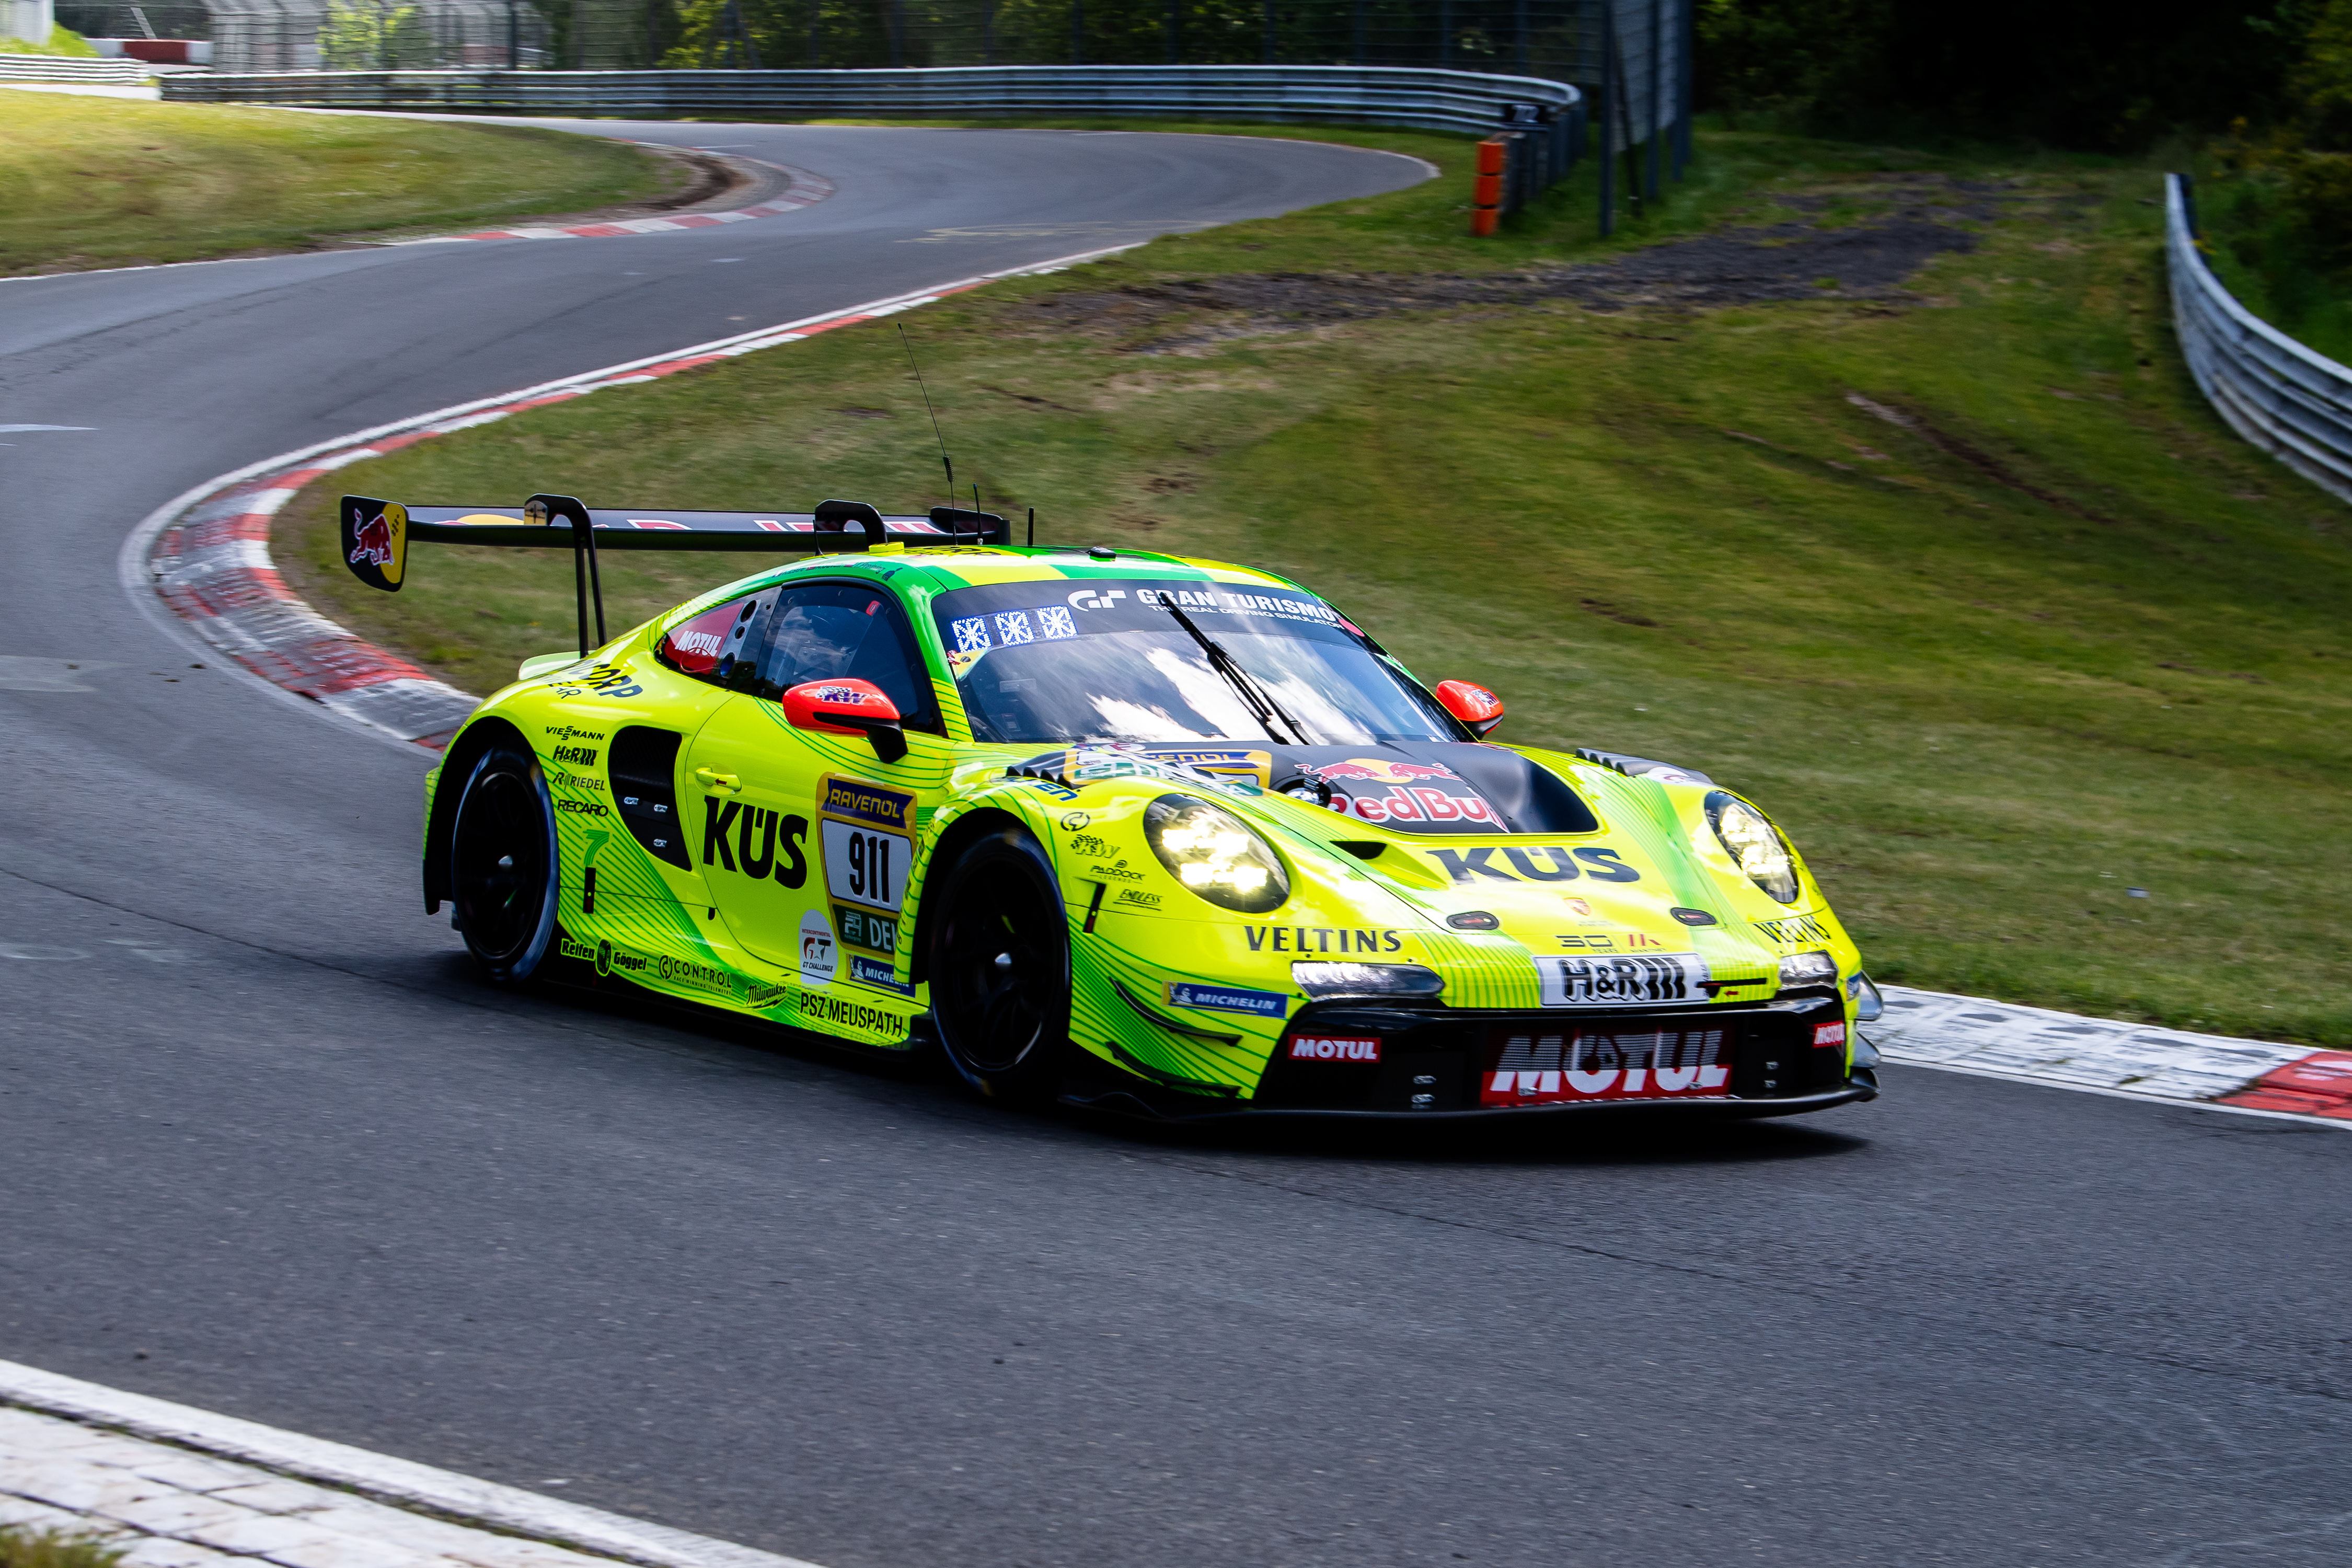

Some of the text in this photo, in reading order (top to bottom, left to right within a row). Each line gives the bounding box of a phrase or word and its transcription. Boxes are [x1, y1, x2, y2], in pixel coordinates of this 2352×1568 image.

[1136, 589, 1219, 607] GRAN
[1220, 592, 1336, 622] TURISMO
[1218, 607, 1275, 618] DRIVING
[1274, 612, 1345, 630] SIMULATOR
[674, 630, 722, 657] MOTUL
[546, 725, 605, 741] VIESSMANN
[552, 745, 584, 765] H&R
[570, 775, 605, 791] RIEDEL
[557, 799, 609, 817] RECARO
[829, 788, 900, 818] RAVENOL
[703, 794, 809, 890] KÜS
[849, 831, 890, 904] 911
[1090, 865, 1146, 881] PADDOCK
[1425, 847, 1641, 885] KÜS
[1119, 889, 1165, 904] ENDLESS
[801, 928, 831, 938] INTERCONTINENTAL
[869, 917, 899, 951] DE
[1243, 925, 1401, 953] VELTINS
[561, 940, 648, 971] Reifen Göggel
[809, 962, 834, 972] CHALLENGE
[674, 960, 732, 988] CONTROL
[1558, 959, 1657, 1002] H&R
[744, 983, 787, 1005] Milwaukee
[1195, 993, 1277, 1010] MICHELIN
[800, 991, 903, 1037] PSZ MEUSPATH
[1291, 1038, 1378, 1060] MOTUL
[1489, 1030, 1728, 1094] MOTUL
